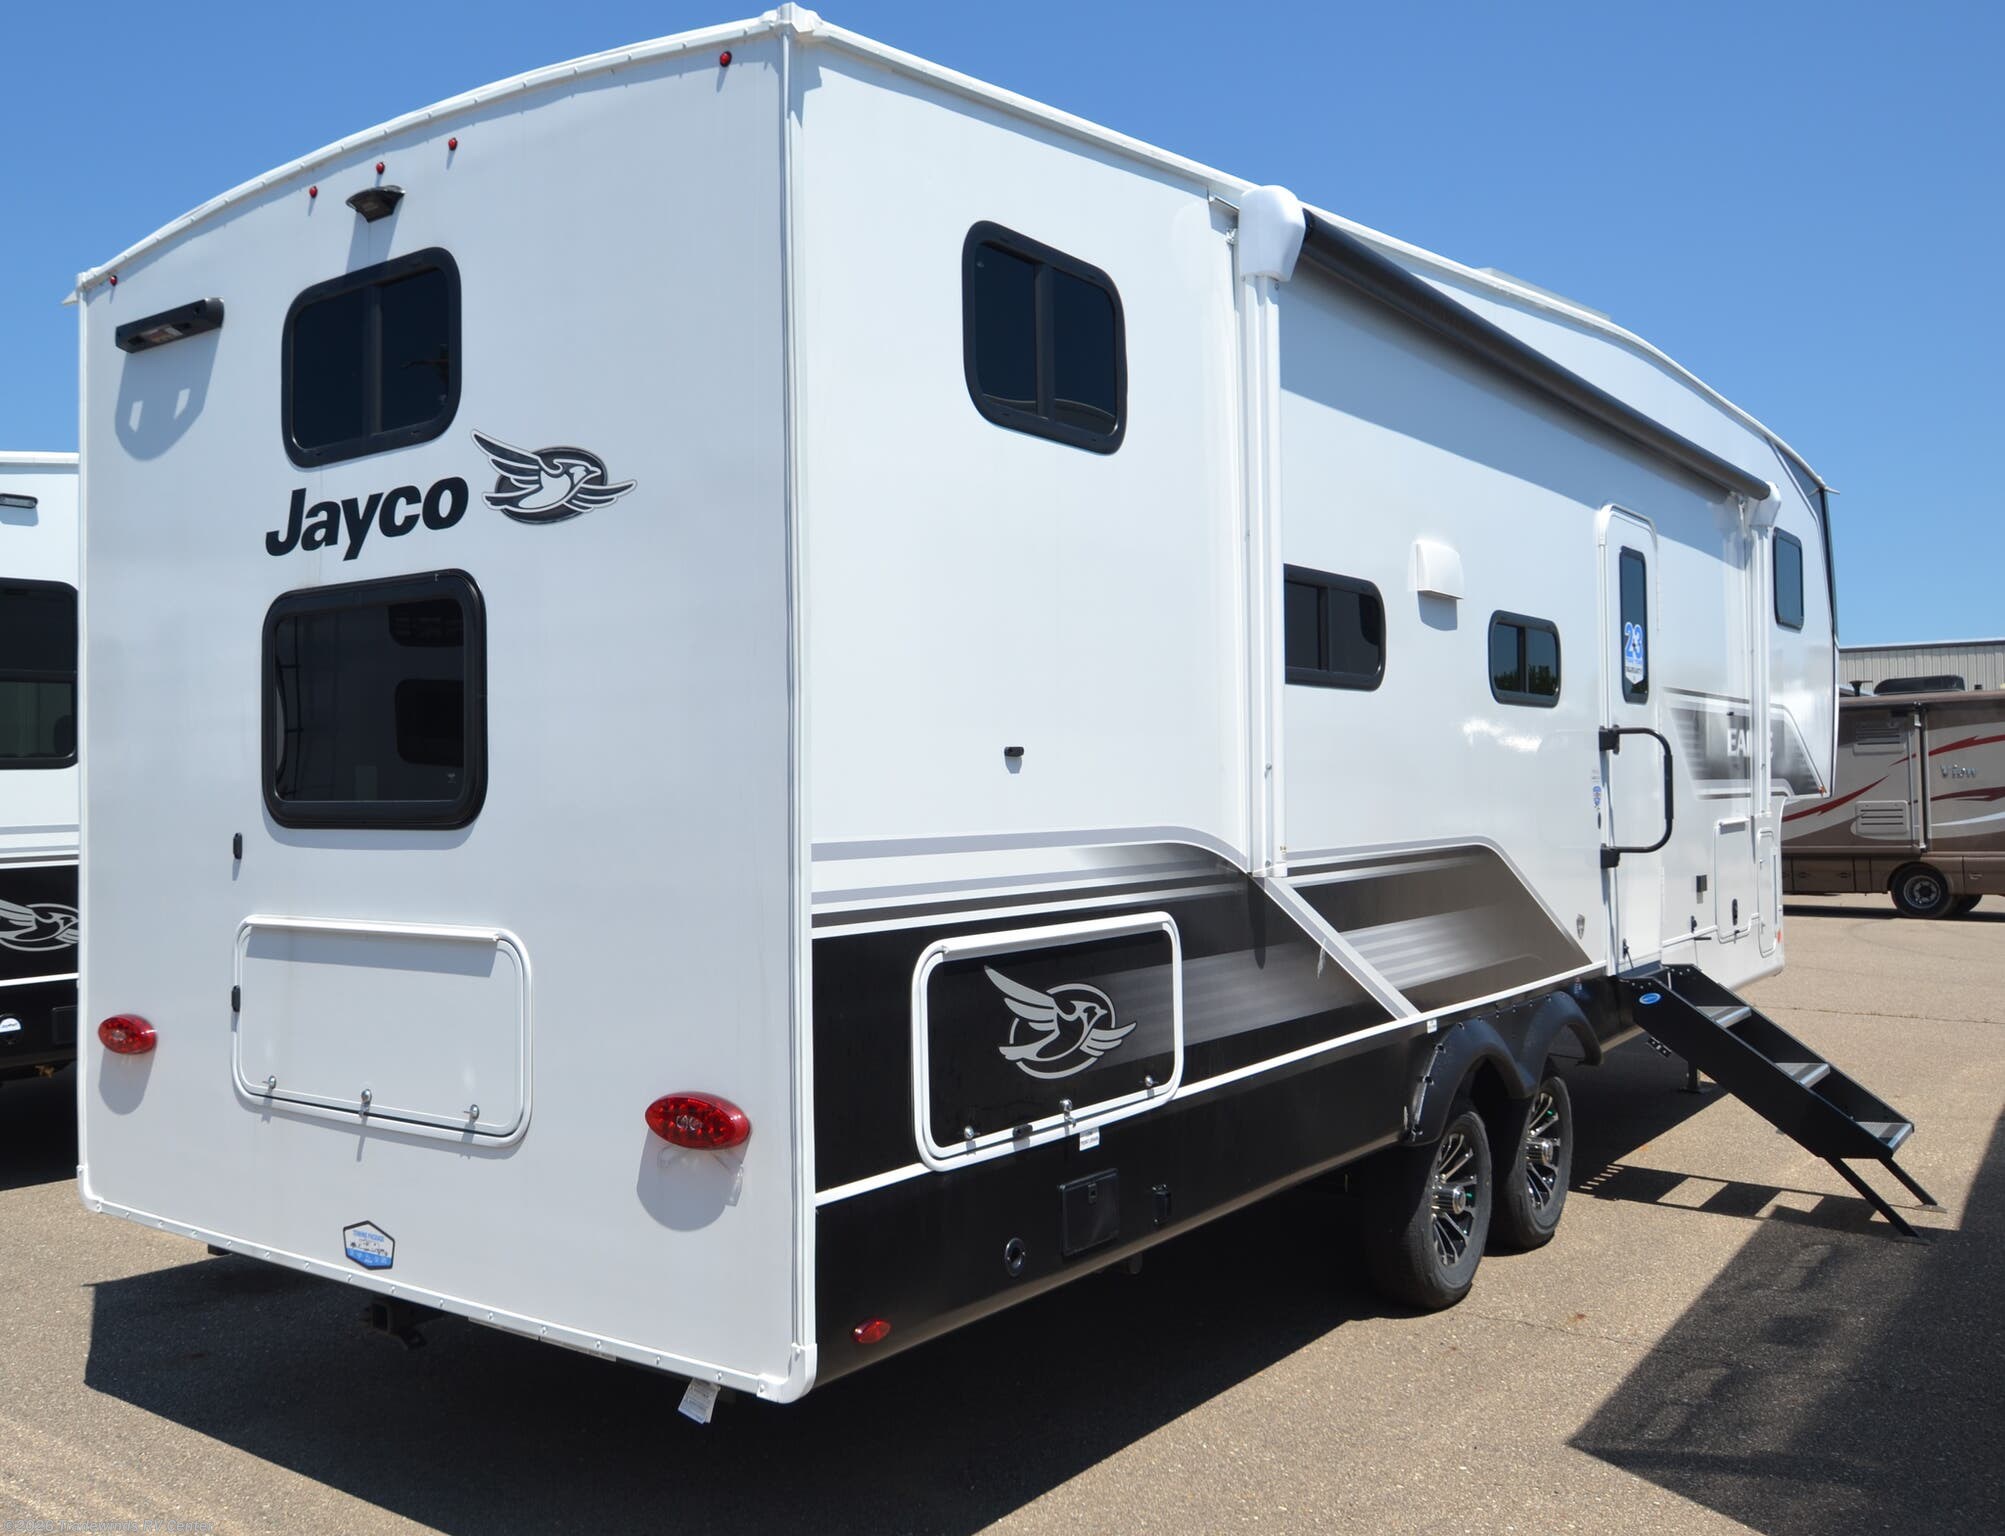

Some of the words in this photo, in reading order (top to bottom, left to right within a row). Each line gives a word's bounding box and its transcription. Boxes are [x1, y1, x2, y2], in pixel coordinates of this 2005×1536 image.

[265, 476, 469, 561] Jayco
[1625, 622, 1644, 660] 23
[1941, 763, 1977, 778] View
